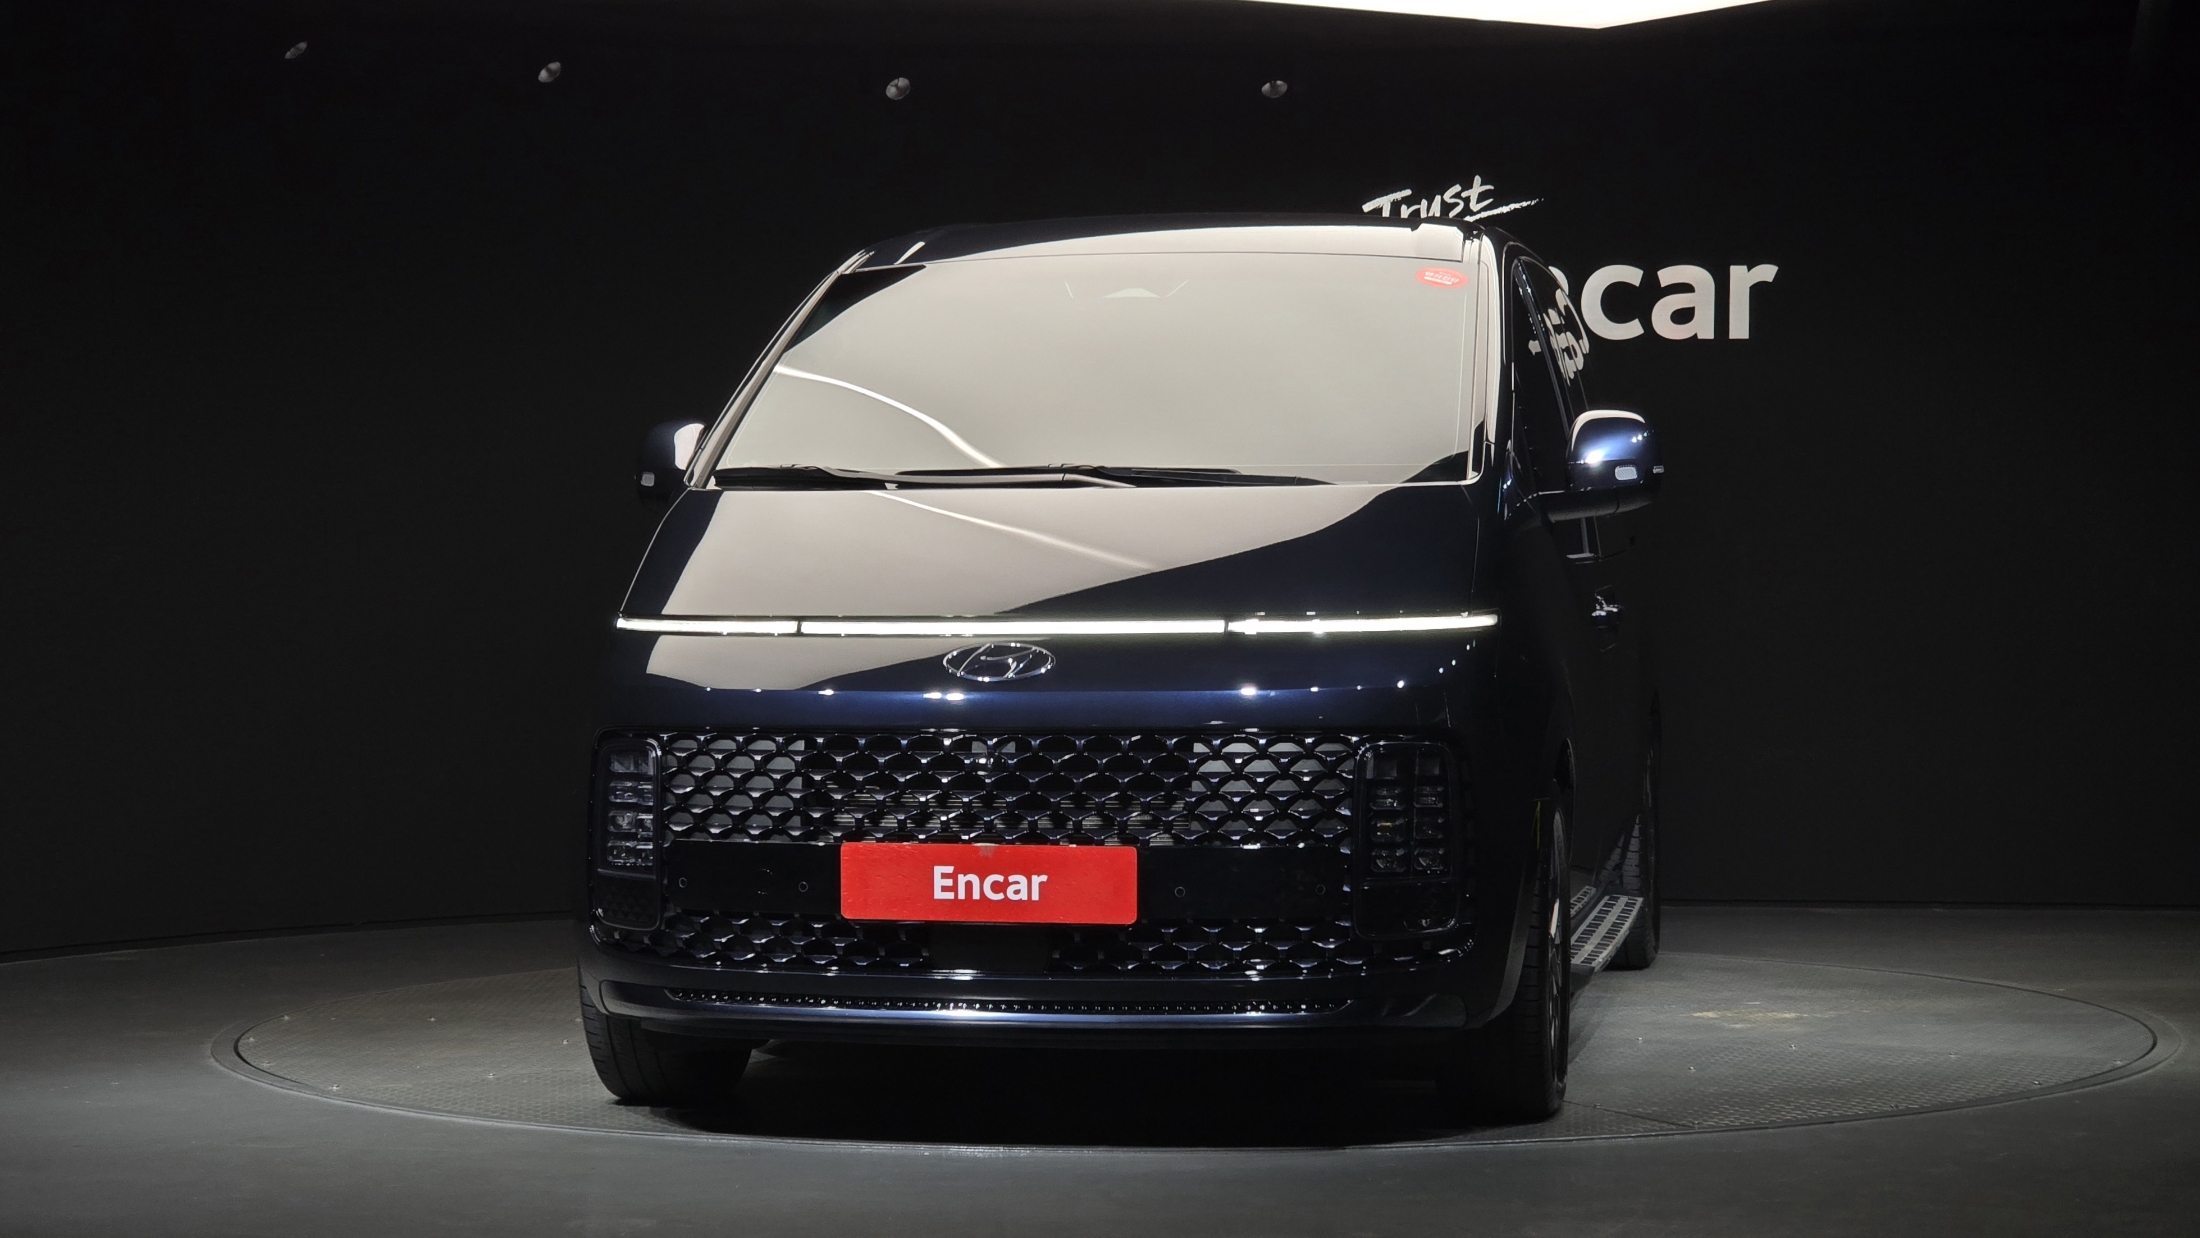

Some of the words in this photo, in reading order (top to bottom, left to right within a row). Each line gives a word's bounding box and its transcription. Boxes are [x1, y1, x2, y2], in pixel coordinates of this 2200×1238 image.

[1361, 174, 1495, 219] Trust
[1547, 263, 1779, 341] car
[933, 865, 1048, 901] Encar
